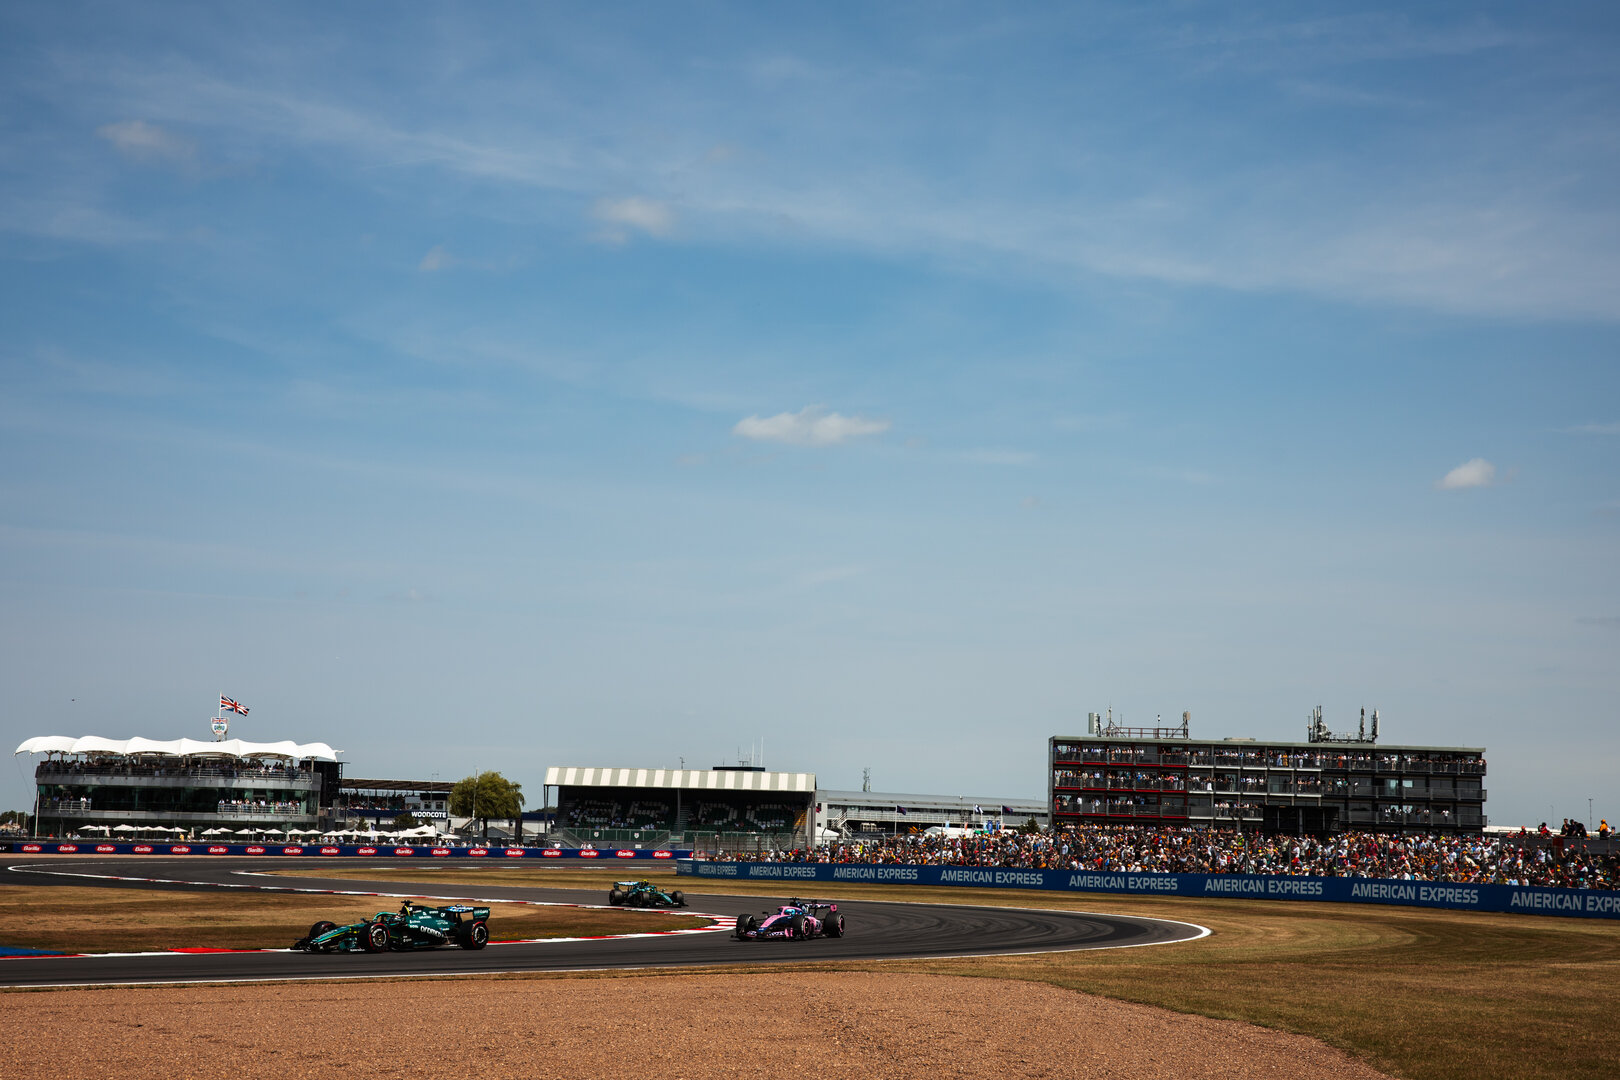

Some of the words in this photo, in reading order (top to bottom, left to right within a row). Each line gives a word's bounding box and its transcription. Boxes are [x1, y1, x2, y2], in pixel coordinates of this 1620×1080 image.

[698, 865, 717, 874] AMERICAN
[717, 865, 738, 875] EXPRESS
[749, 866, 782, 876] AMERICAN
[783, 867, 816, 877] EXPRESS
[833, 867, 876, 879] AMERICAN
[877, 868, 918, 880] EXPRESS
[940, 870, 993, 883] AMERICAN
[995, 872, 1043, 885] EXPRESS
[1069, 875, 1125, 889] AMERICAN
[1128, 876, 1178, 891] EXPRESS
[1204, 878, 1265, 893] AMERICAN
[1268, 880, 1323, 895] EXPRESS
[1351, 882, 1416, 900] AMERICAN
[1419, 886, 1479, 904] EXPRESS
[1510, 891, 1582, 911] AMERICAN
